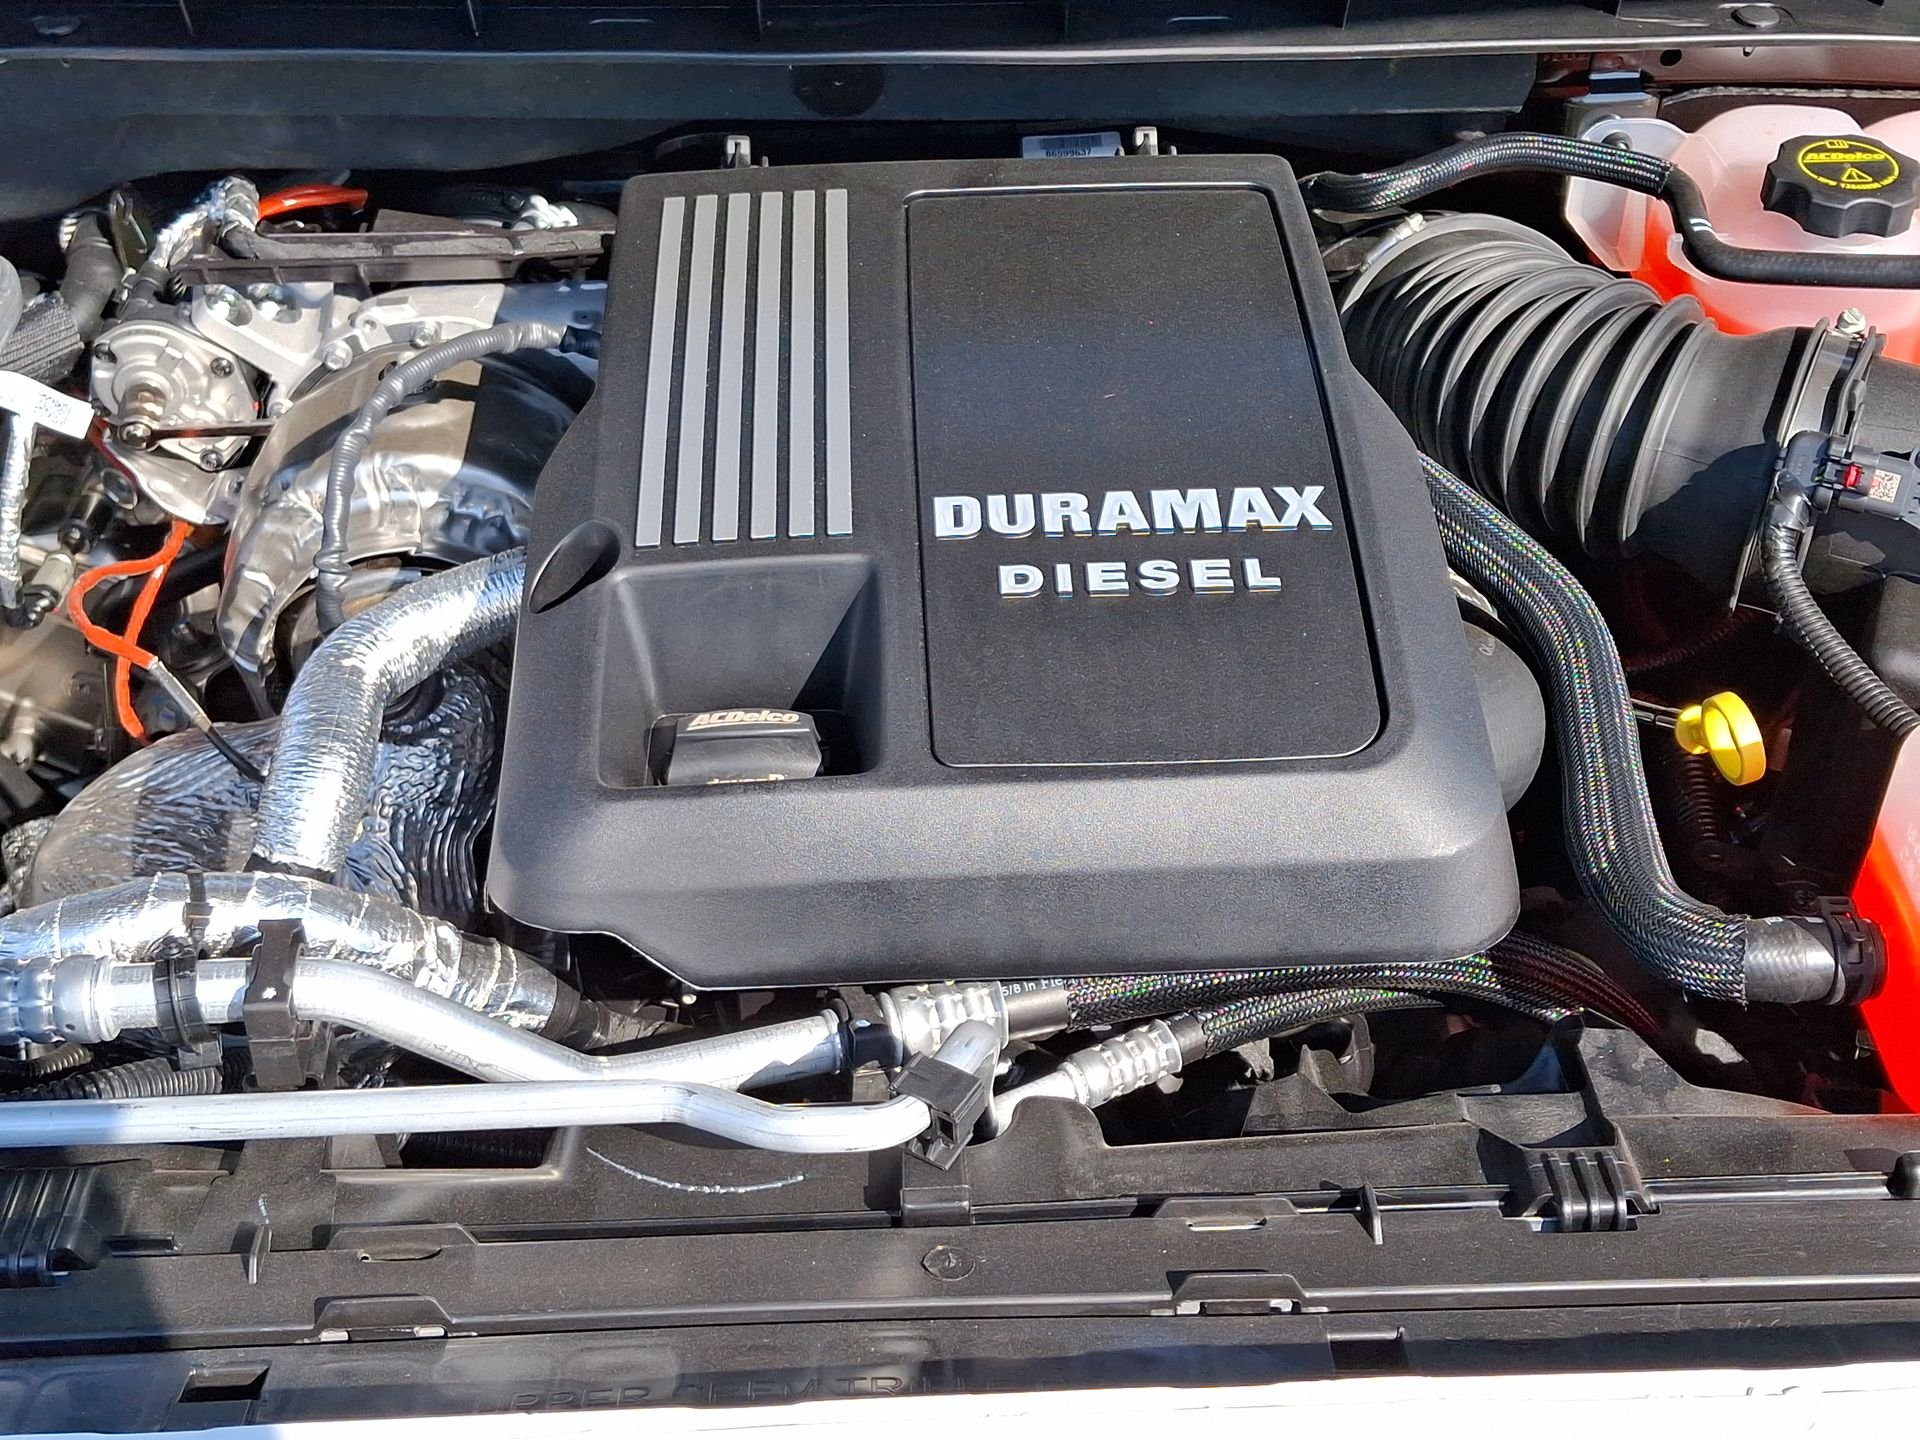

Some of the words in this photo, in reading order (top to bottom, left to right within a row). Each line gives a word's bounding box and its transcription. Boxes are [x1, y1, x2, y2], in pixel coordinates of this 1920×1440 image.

[1805, 151, 1886, 161] ACDelco
[933, 486, 1333, 540] DURAMAX
[998, 558, 1282, 598] DIESEL
[688, 710, 800, 727] ACDelco
